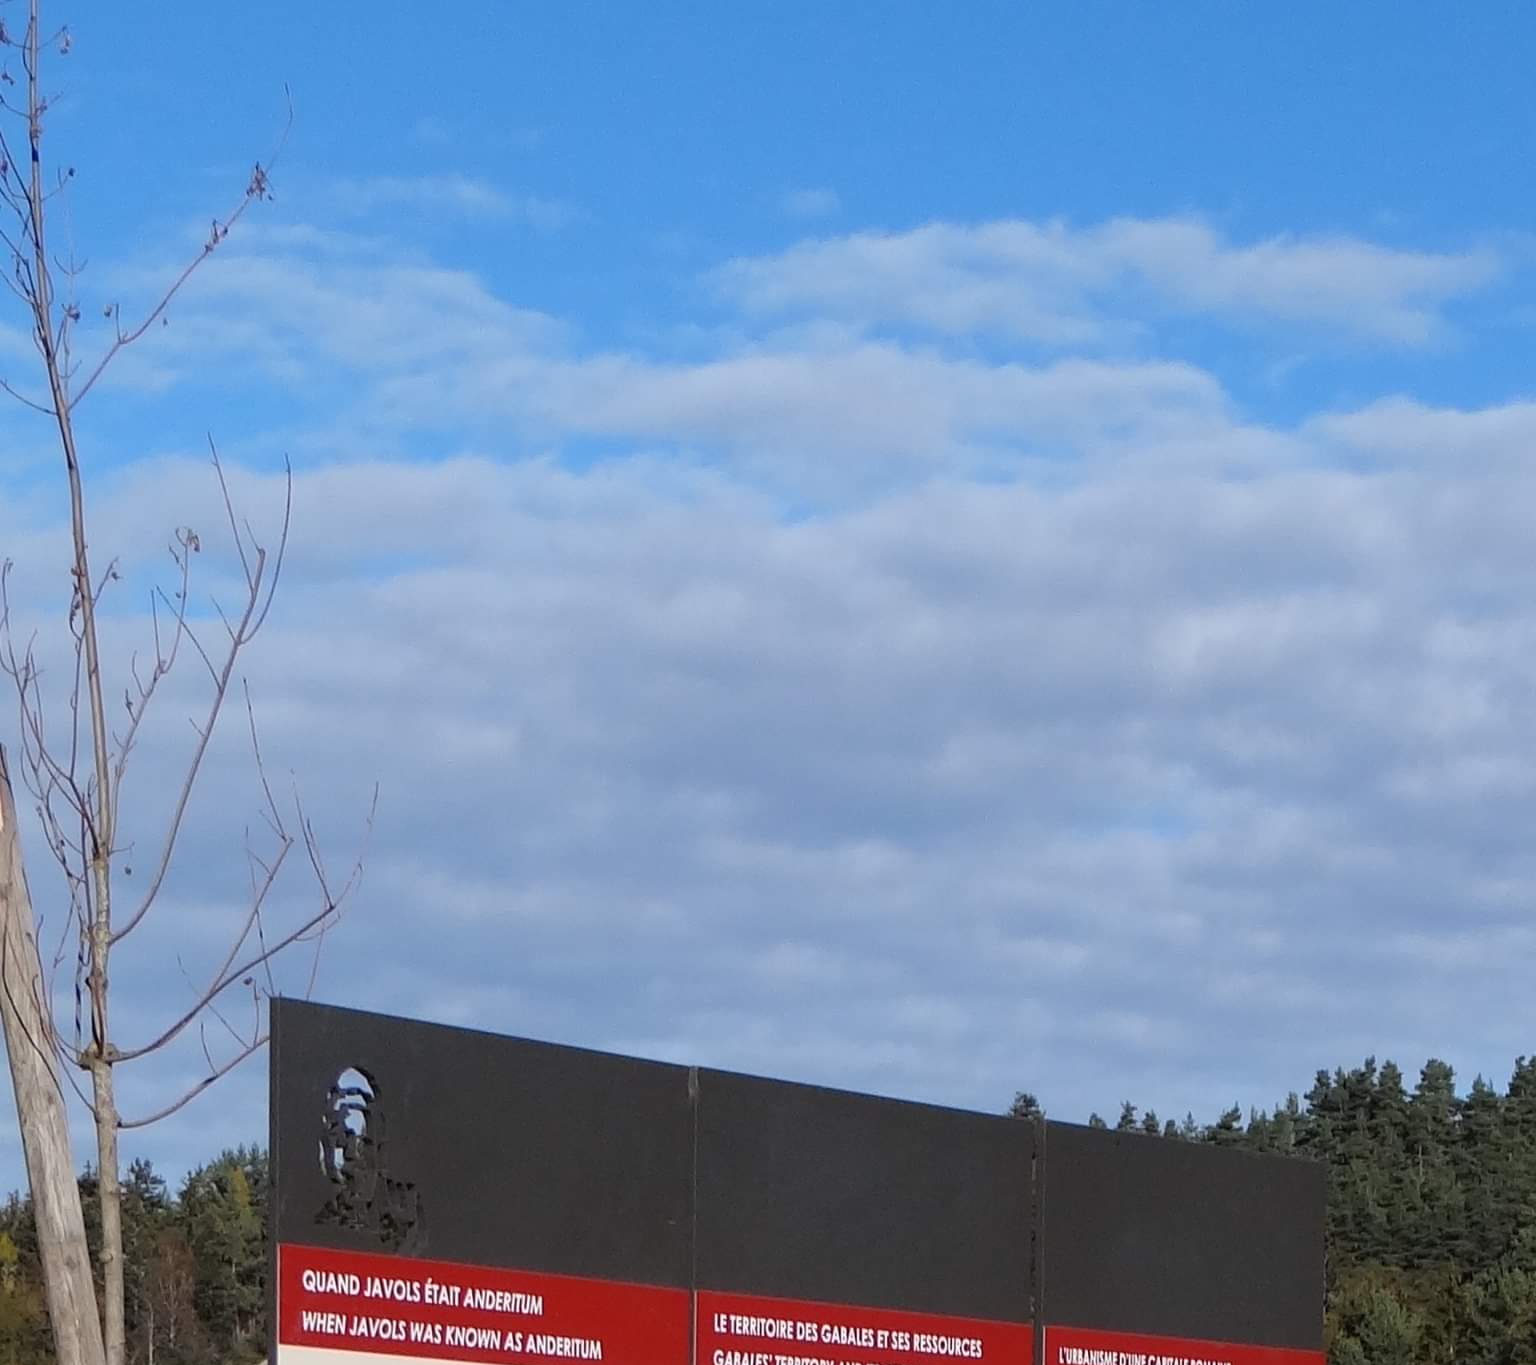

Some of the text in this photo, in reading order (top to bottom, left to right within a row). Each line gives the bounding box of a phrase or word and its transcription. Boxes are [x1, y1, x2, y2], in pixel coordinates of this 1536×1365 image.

[302, 1270, 542, 1315] QUAND JAVOLS ÉTAIT ANDERITUM
[302, 1312, 602, 1360] WHEN JAVOLS WAS KNOWN AS ANDERITUM
[714, 1314, 982, 1358] LE TERRITOIRE DES GABALES ET SES RESSOURCES
